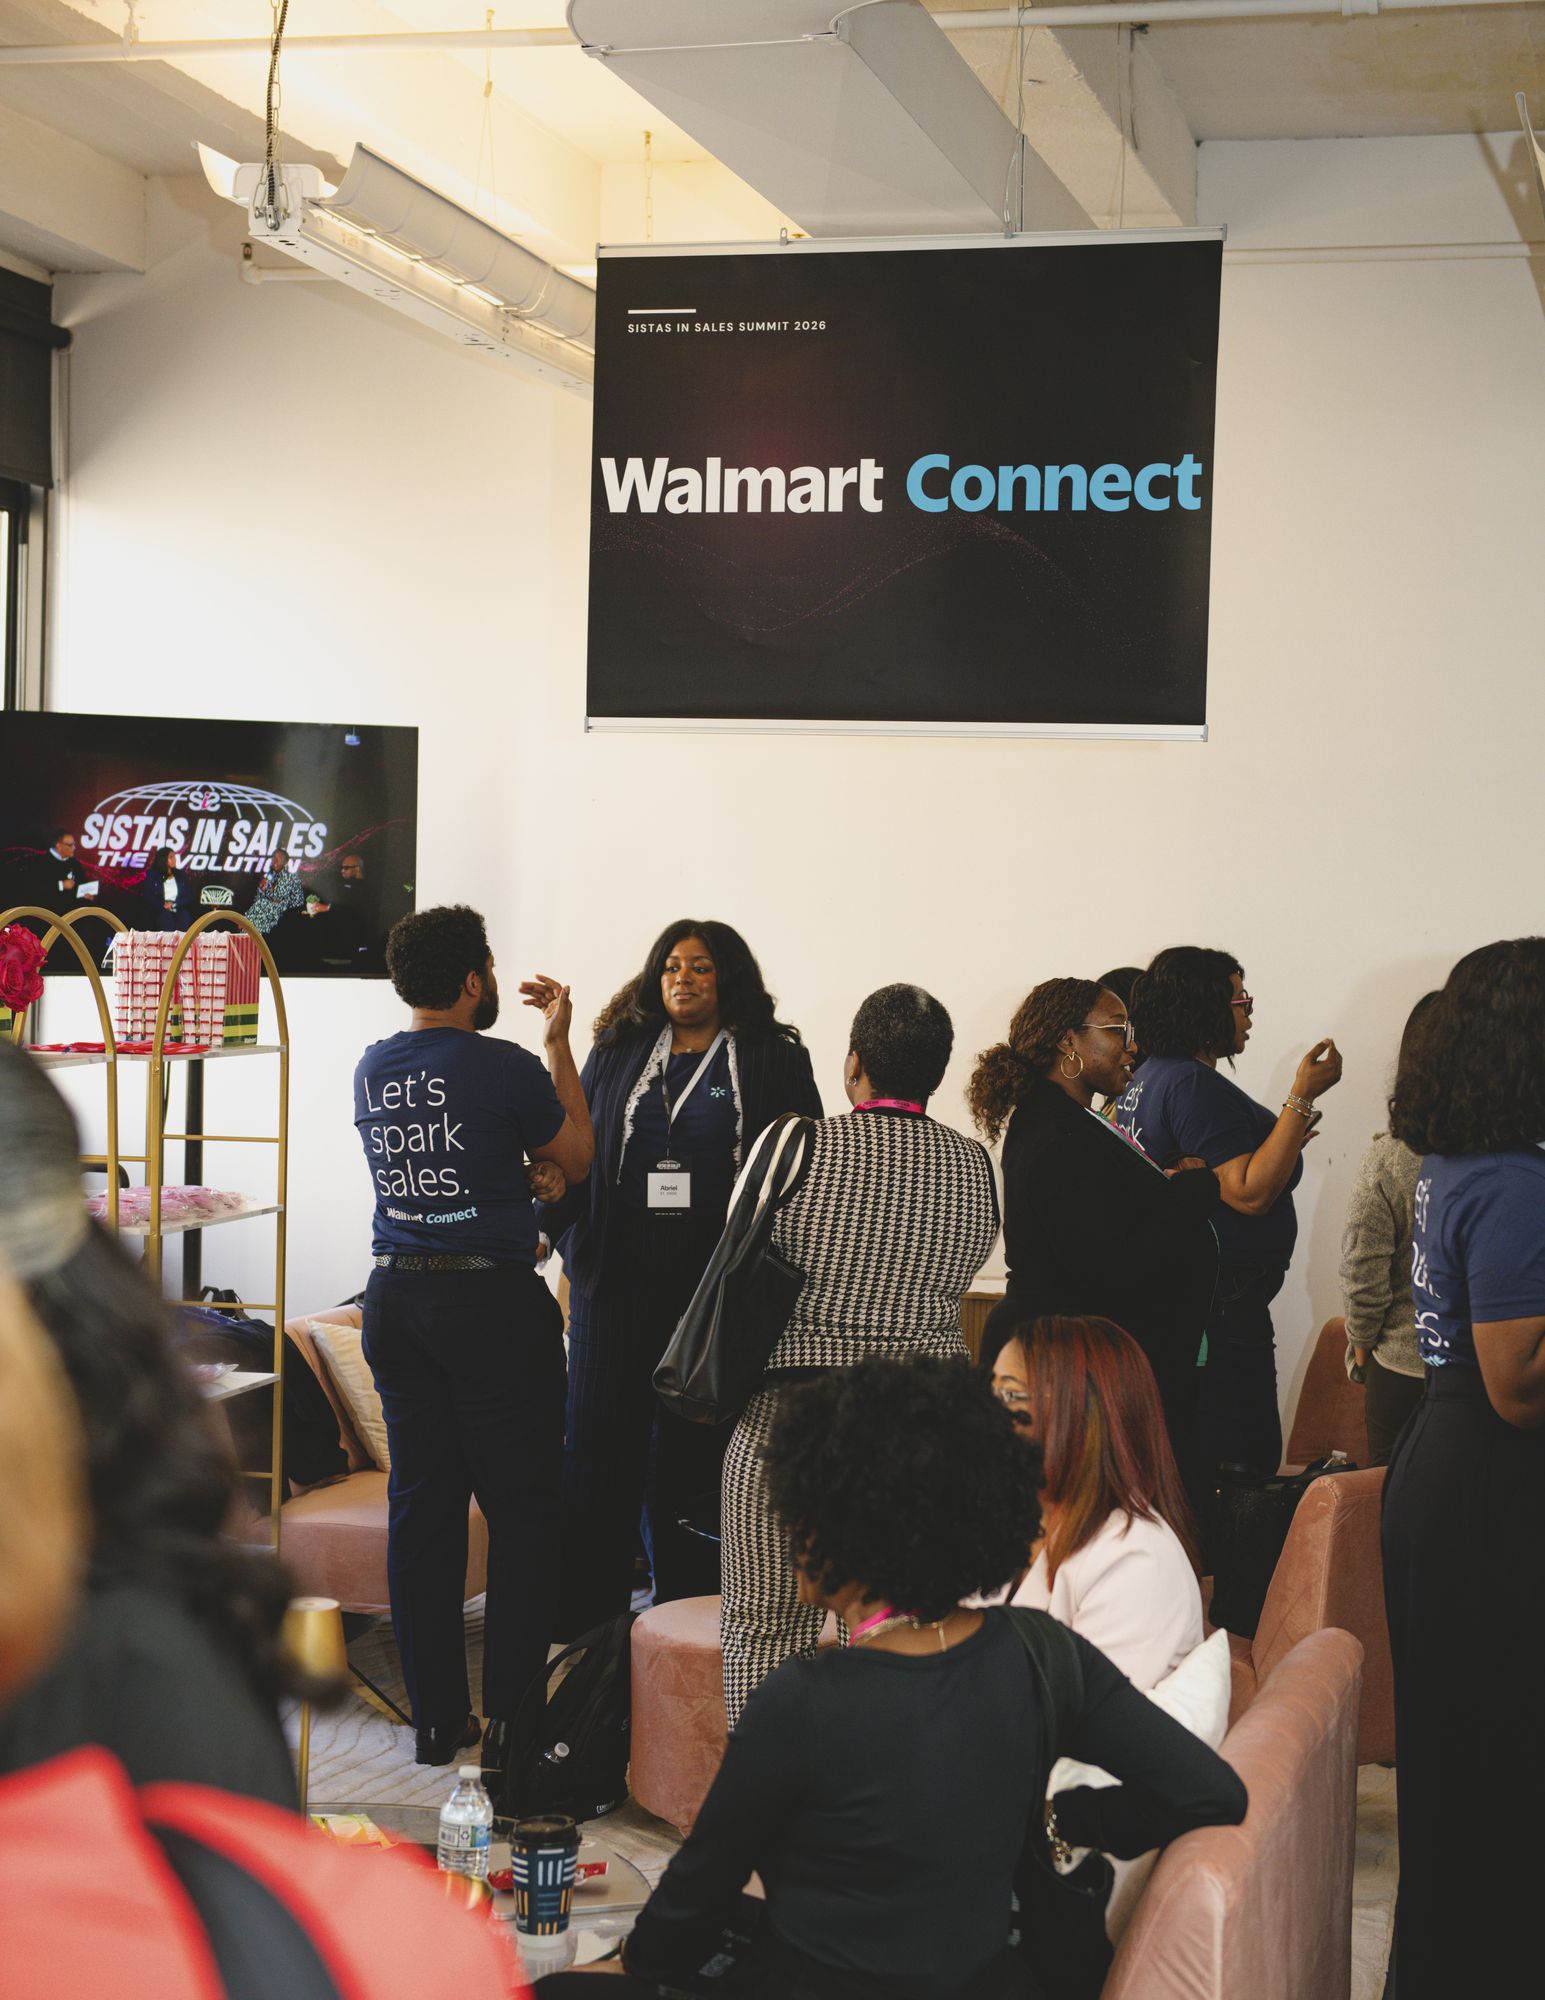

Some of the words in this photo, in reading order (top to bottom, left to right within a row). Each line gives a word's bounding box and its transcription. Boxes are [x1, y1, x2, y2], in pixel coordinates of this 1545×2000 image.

[627, 323, 672, 333] SISTAS
[677, 323, 689, 332] IN
[694, 322, 734, 332] SALES
[739, 321, 789, 331] SUMMIT
[794, 320, 826, 331] 2026
[600, 457, 884, 514] Walmart
[906, 453, 1202, 513] Connect
[80, 813, 189, 852] SISTAS
[190, 818, 226, 853] IN
[228, 819, 327, 858] SALES
[98, 851, 149, 868] THE
[364, 1070, 446, 1112] Let's
[370, 1112, 465, 1162] spark
[376, 1159, 470, 1197] sales.
[426, 1206, 478, 1224] Connect
